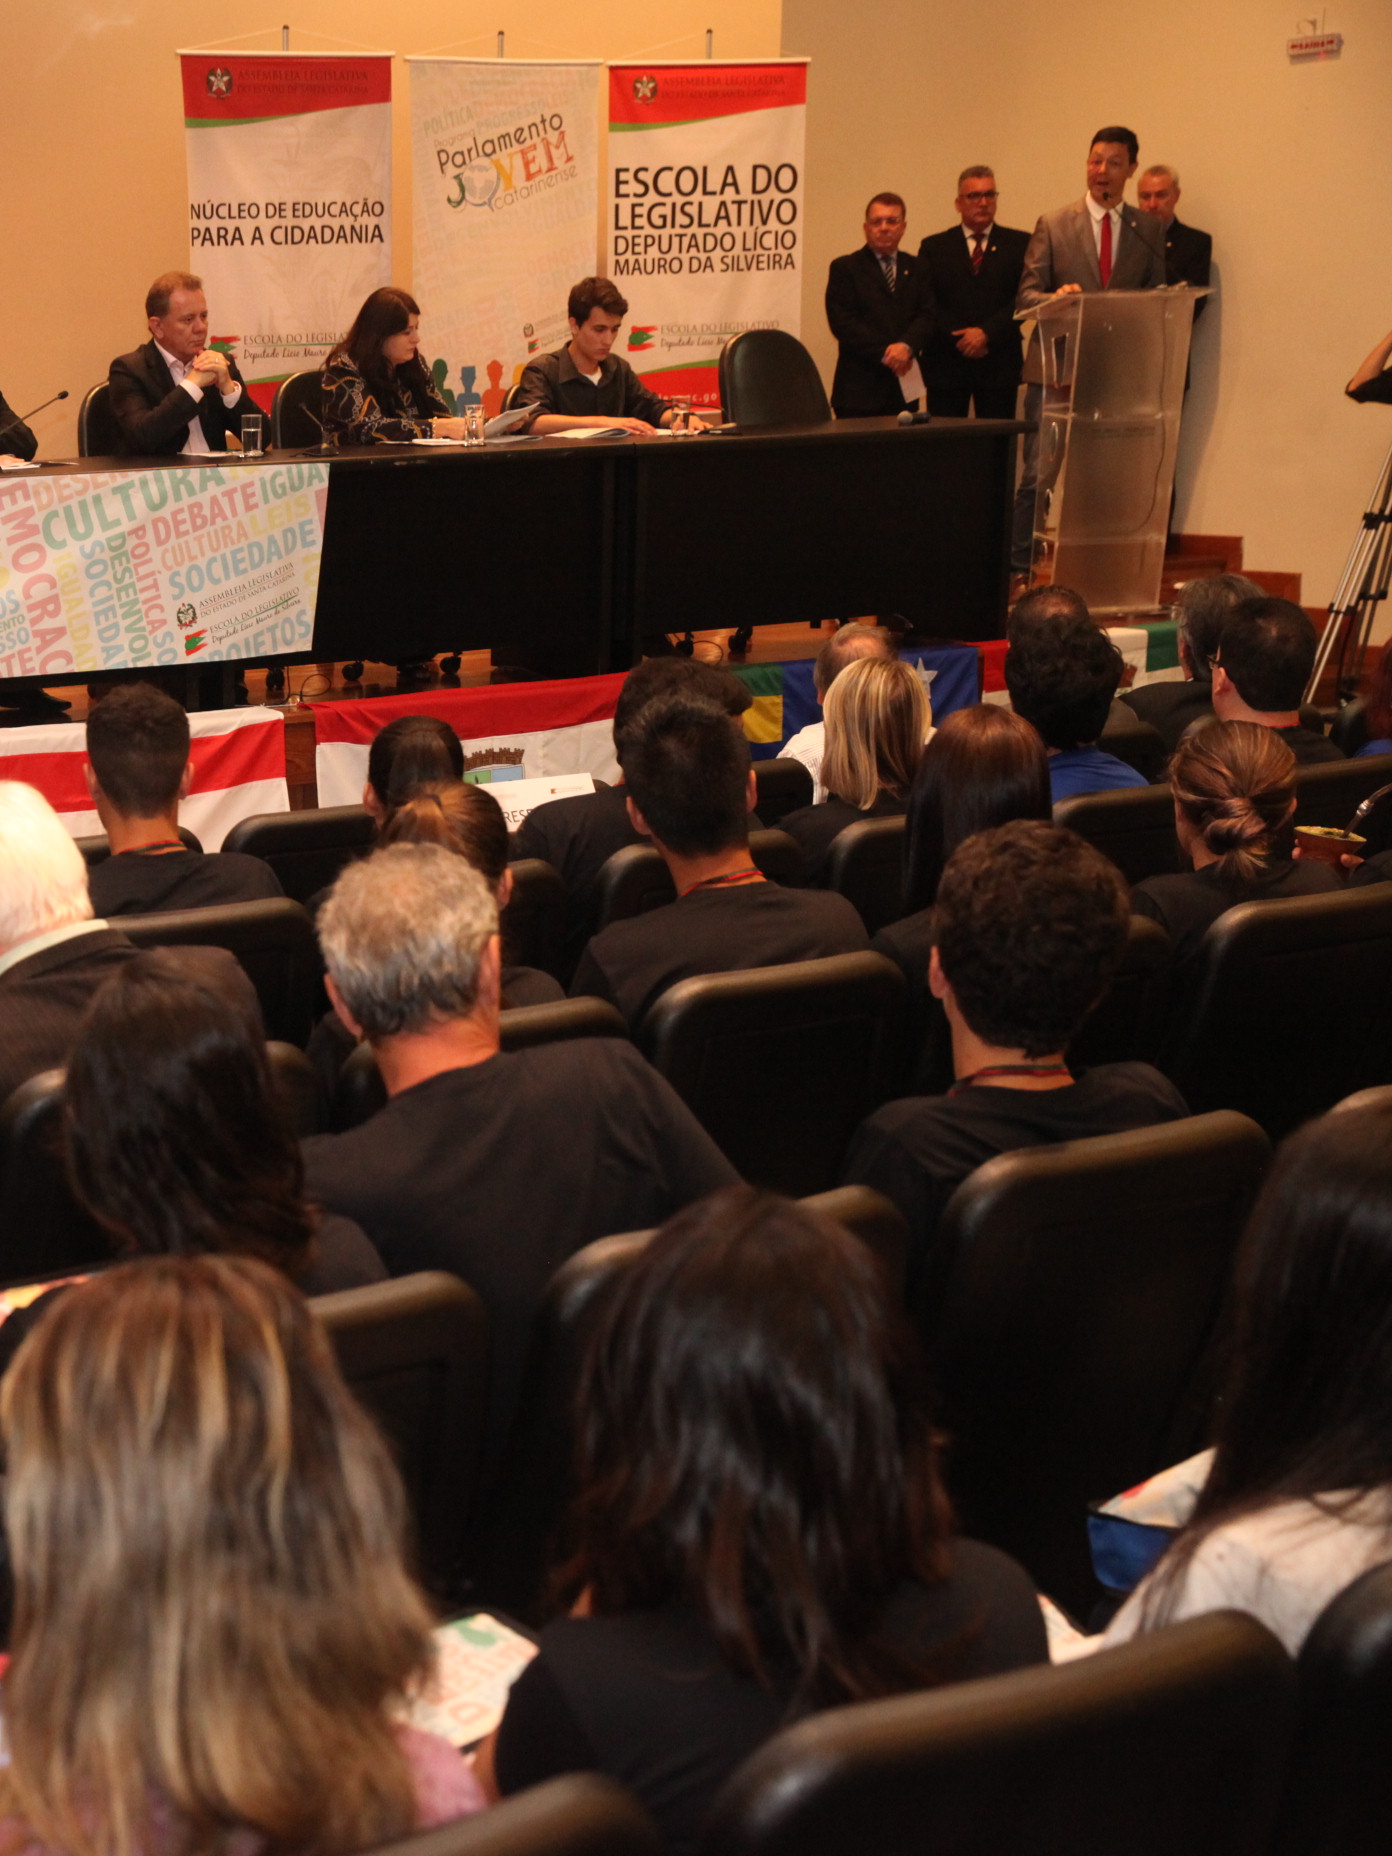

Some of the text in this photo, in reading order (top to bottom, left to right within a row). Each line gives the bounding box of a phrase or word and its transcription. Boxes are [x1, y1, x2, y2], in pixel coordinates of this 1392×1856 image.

[436, 113, 564, 175] Parlamento
[493, 165, 578, 211] catarinense
[615, 163, 798, 198] ESCOLA DO
[190, 198, 385, 222] NÚCLEO DE EDUCAÇÃO
[614, 198, 797, 231] LEGISLATIVO
[191, 224, 385, 247] PARA A CIDADANIA
[614, 226, 796, 256] DEPUTADO LÍCIO
[614, 252, 796, 276] MAURO DA SILVEIRA
[243, 333, 283, 345] ESCOLA
[286, 333, 302, 344] DO
[660, 323, 698, 334] ESCOLA
[701, 322, 717, 333] DO
[42, 466, 226, 551] CULTURA
[151, 480, 260, 548] DEBATE
[250, 493, 312, 538] LEIS
[160, 519, 250, 572] CULTURA
[168, 518, 317, 601] SOCIEDADE
[127, 523, 168, 637] POLÍTICA
[198, 583, 247, 609] ASSEMBLEIA
[247, 562, 294, 590] LEGISLATIVA
[200, 571, 296, 619] DO ESTADO DE SANTA CATARINA
[209, 586, 300, 634] ESCOLA DO LEGISLATIVO
[211, 628, 239, 645] Deputado
